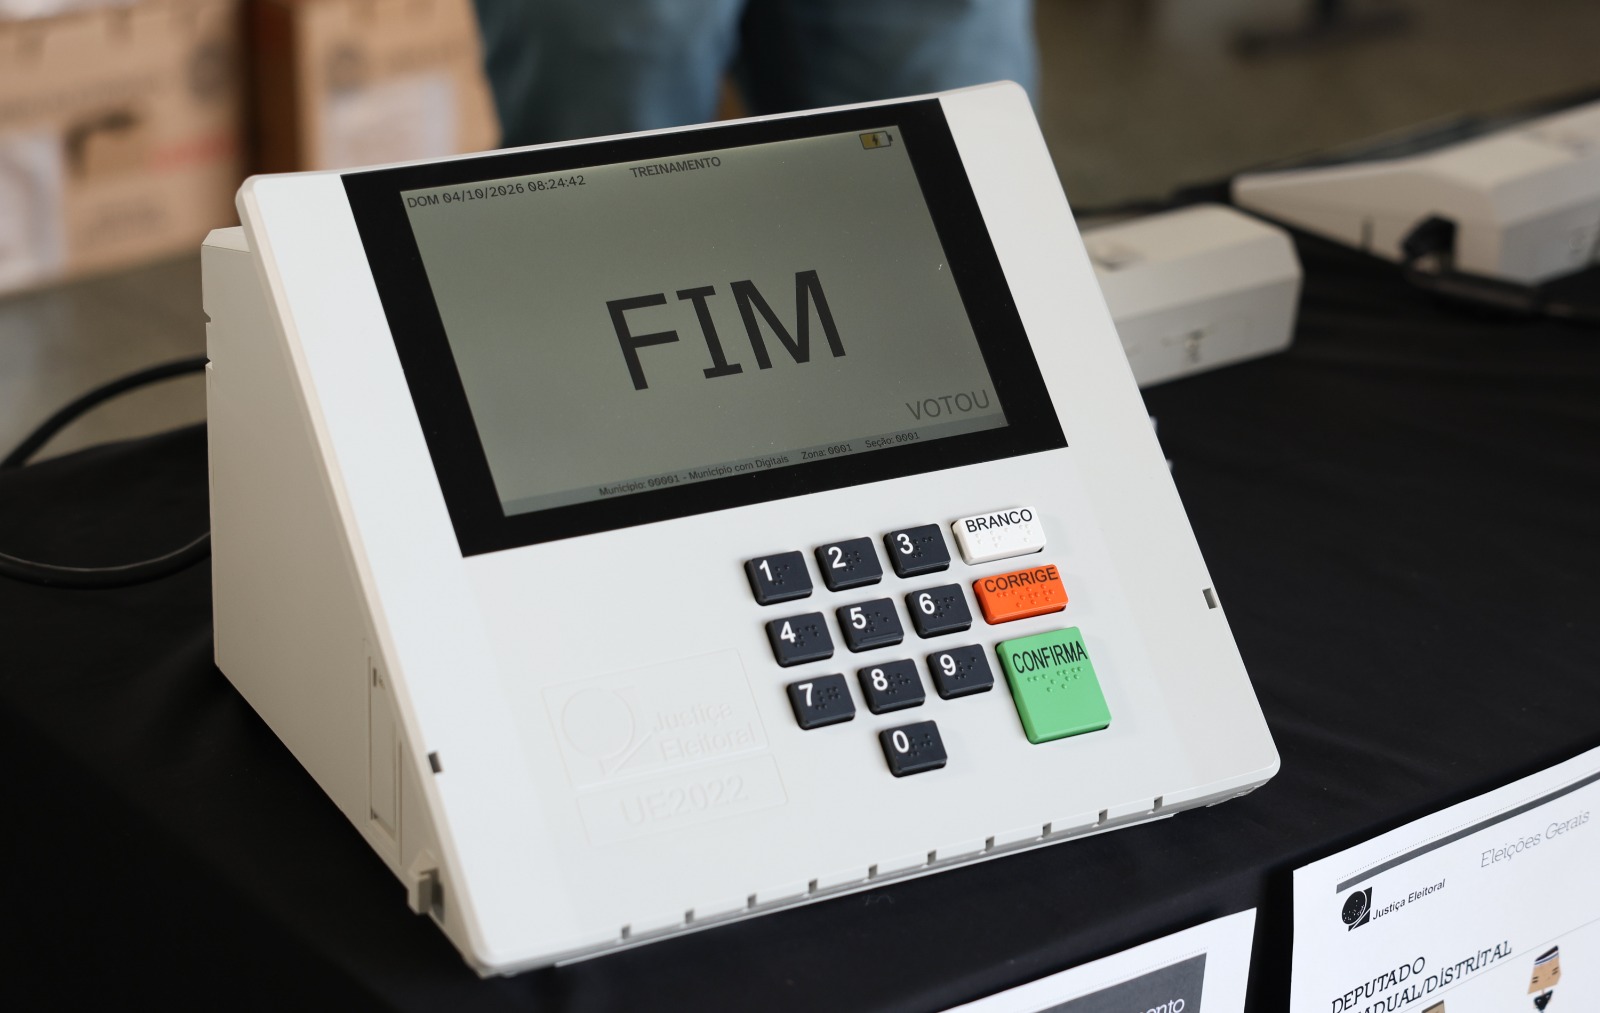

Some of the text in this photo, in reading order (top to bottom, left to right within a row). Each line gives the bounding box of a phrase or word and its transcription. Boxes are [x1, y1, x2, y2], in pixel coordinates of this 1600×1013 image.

[629, 156, 721, 178] TREINAMENTO
[407, 175, 587, 208] DOM 04/10/2026 08:24:42
[606, 269, 846, 391] FIM
[906, 389, 990, 420] VOTOU
[598, 480, 646, 497] Município:
[648, 474, 680, 487] 00001
[688, 466, 733, 481] Município
[735, 463, 754, 473] com
[755, 455, 789, 469] Digitais
[801, 449, 827, 461] Zona:
[827, 443, 853, 455] 0001
[864, 436, 895, 450] Seção:
[895, 431, 920, 444] 0001
[965, 508, 1033, 533] BRANCO
[896, 533, 914, 555] 3
[758, 559, 773, 581] 1
[828, 546, 846, 569] 2
[984, 567, 1059, 594] CORRIGE
[919, 593, 936, 614] 6
[850, 607, 867, 629] 5
[780, 621, 796, 643] 4
[939, 654, 957, 676] 9
[1012, 640, 1088, 674] CONFIRMA
[871, 668, 888, 691] 8
[798, 683, 814, 707] 7
[653, 702, 734, 734] Justiça
[659, 721, 756, 763] Eleitoral
[892, 730, 910, 753] 0
[619, 773, 750, 827] UE2022
[1480, 810, 1591, 868] Eleições Gerais
[1372, 878, 1446, 921] Justiça Eleitoral
[1331, 957, 1426, 1013] DEPUTADO
